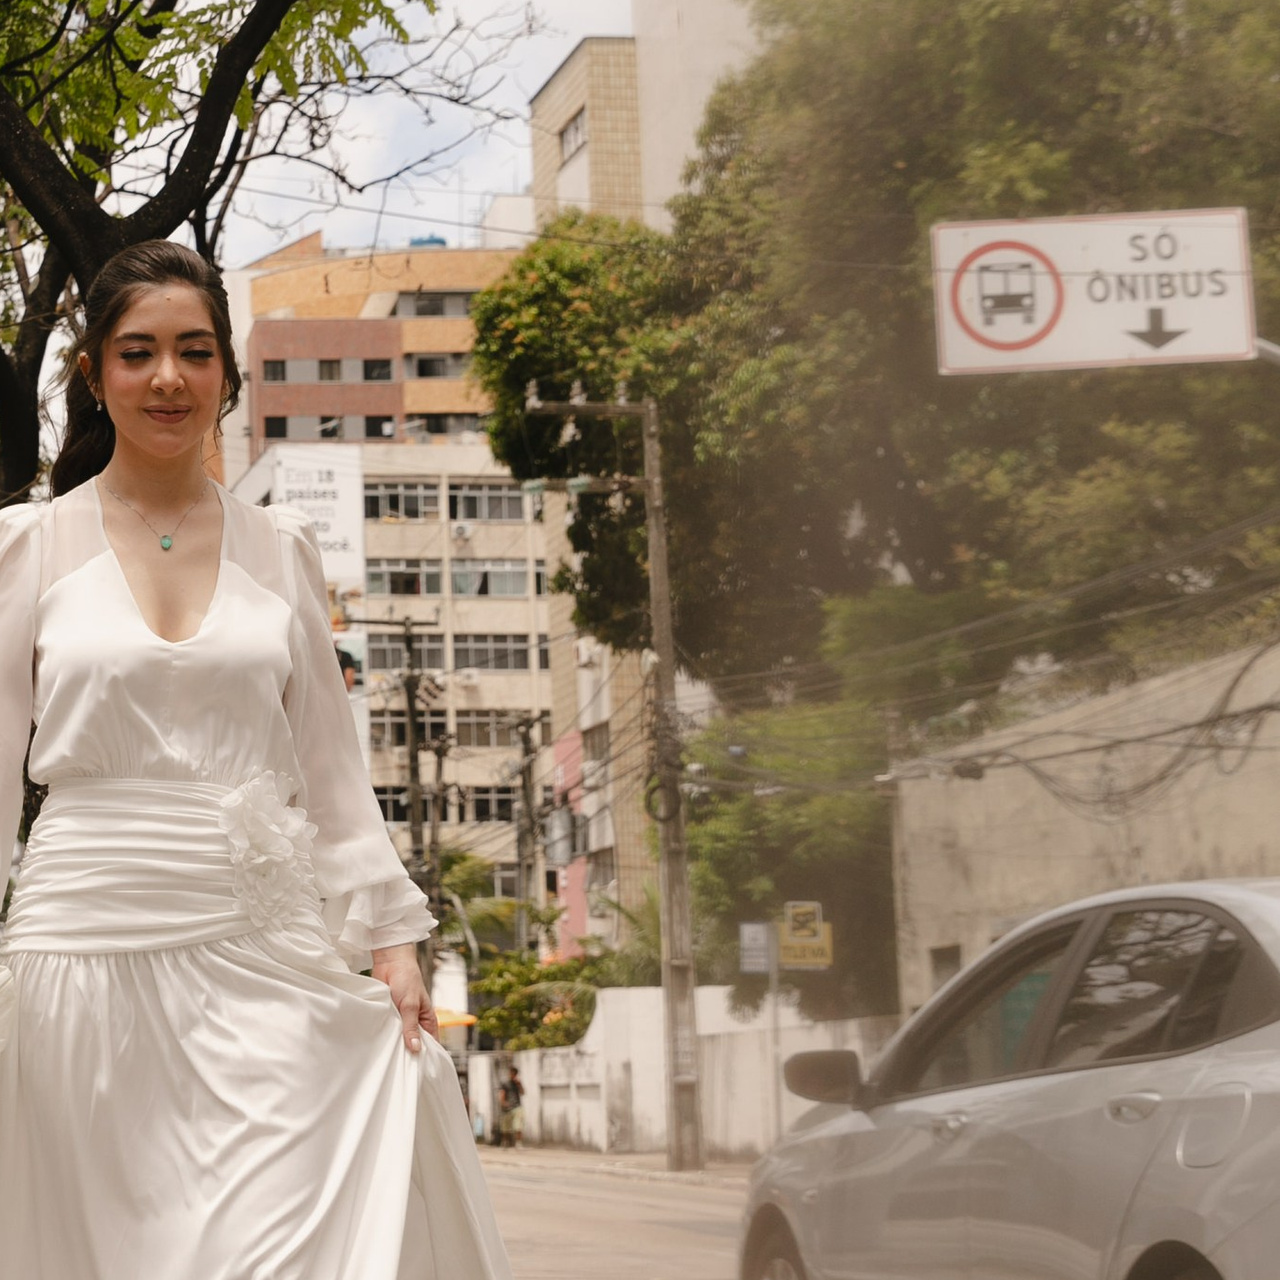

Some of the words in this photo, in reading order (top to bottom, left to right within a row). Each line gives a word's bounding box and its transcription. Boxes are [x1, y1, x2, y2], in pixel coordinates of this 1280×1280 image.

[1128, 225, 1177, 262] SÓ
[1086, 268, 1229, 303] ÔNIBUS
[285, 486, 339, 502] países
